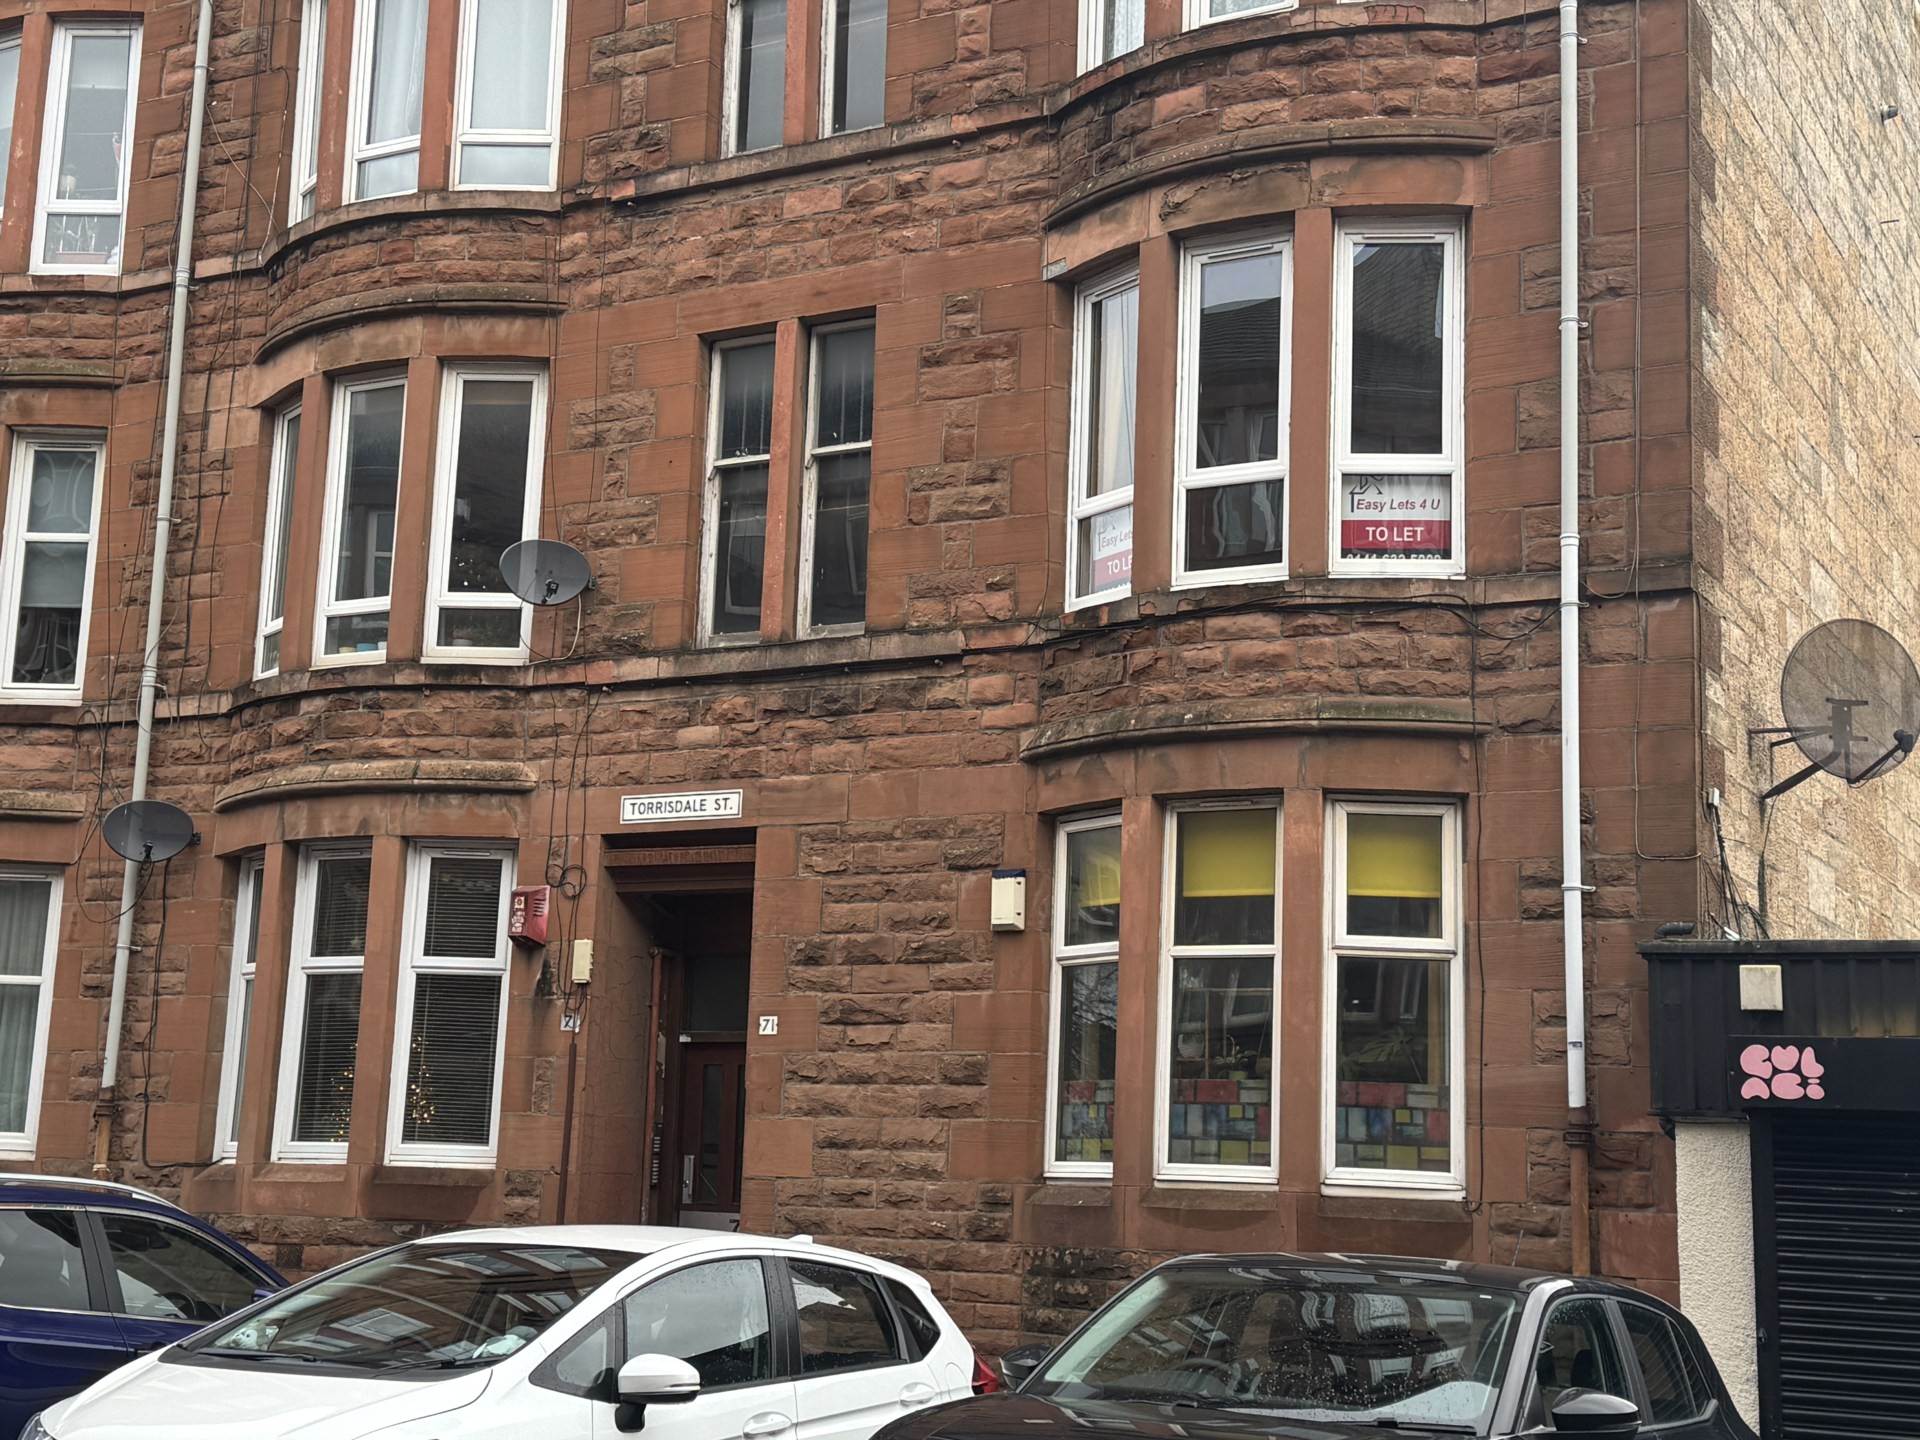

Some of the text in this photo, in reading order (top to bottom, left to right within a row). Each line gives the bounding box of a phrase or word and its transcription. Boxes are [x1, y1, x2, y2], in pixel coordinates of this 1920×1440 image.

[1356, 498, 1441, 513] Easy Lets 4 U
[1101, 534, 1119, 549] Easy
[1365, 526, 1424, 542] TO LET
[1106, 559, 1120, 576] TO
[629, 797, 733, 816] TORRISDALE ST.
[762, 1018, 775, 1032] 71
